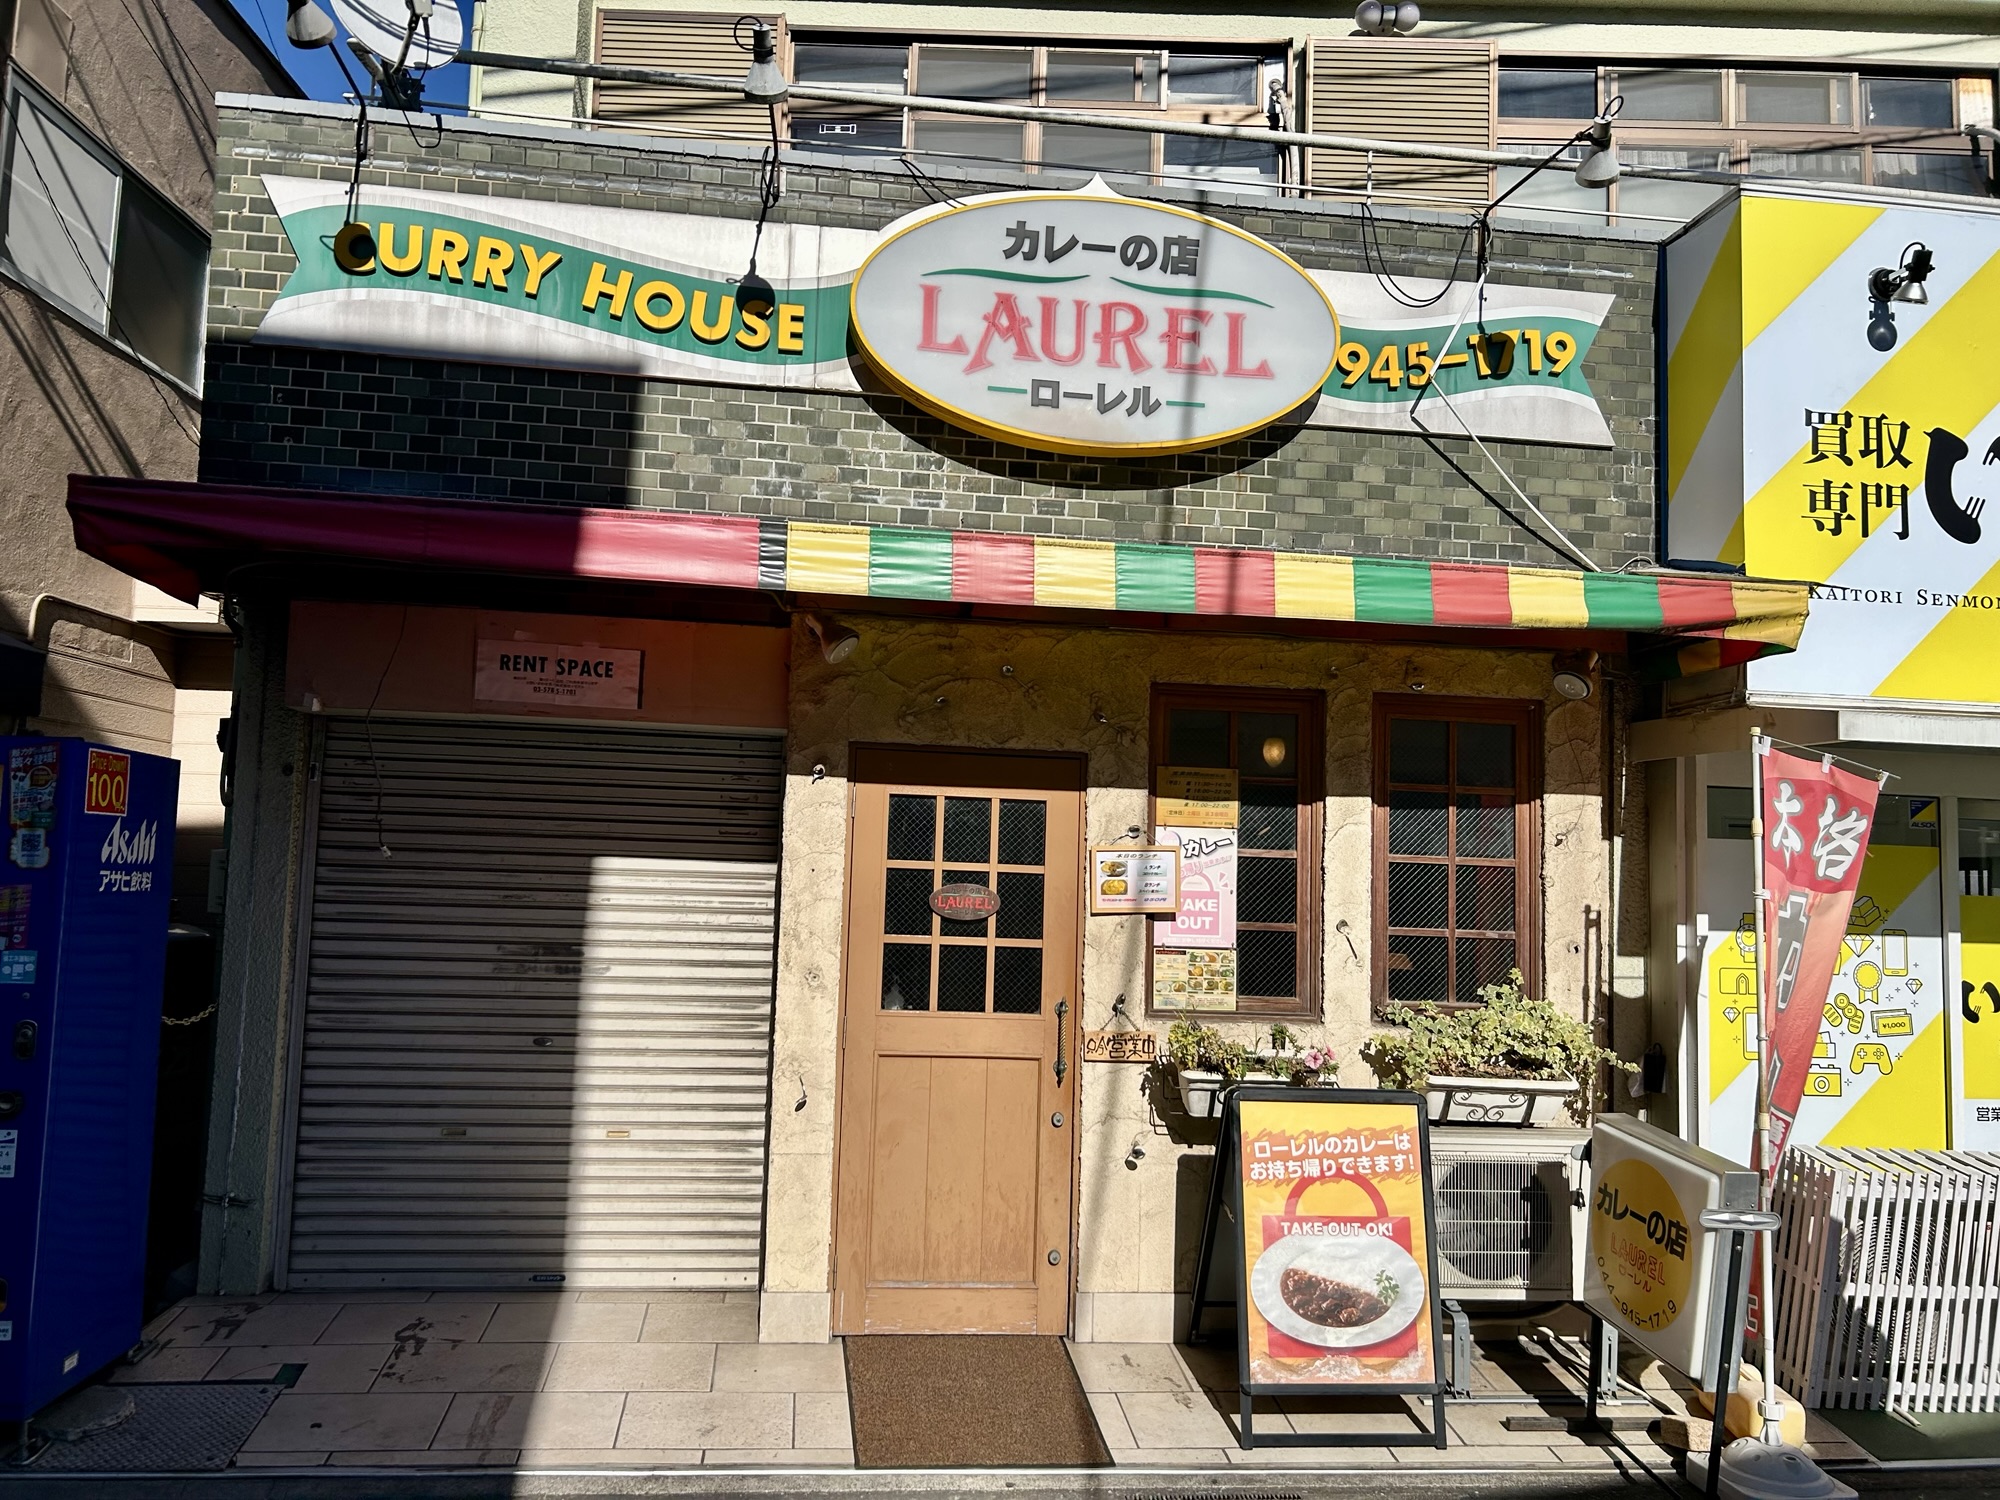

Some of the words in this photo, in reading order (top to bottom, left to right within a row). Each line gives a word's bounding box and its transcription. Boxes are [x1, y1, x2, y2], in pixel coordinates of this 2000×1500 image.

[1001, 220, 1200, 277] カレーの店
[333, 221, 563, 298] CURRY
[580, 261, 806, 354] HOUSE
[916, 283, 1275, 379] LAUREL
[1337, 329, 1578, 388] 945-1719
[1029, 379, 1162, 418] ローレル
[1802, 407, 1913, 469] 買取
[1801, 478, 1910, 541] 専門
[1916, 589, 2000, 610] SENMO
[500, 653, 548, 673] RENT
[556, 657, 614, 679] SPACE
[1771, 781, 1868, 880] 本格
[1911, 821, 1936, 829] ALSOK
[101, 817, 158, 865] Asahi
[1182, 837, 1234, 859] カレー
[98, 870, 152, 892] アサヒ飲料
[937, 896, 993, 910] LAUREL
[1180, 898, 1218, 912] AKE
[1177, 916, 1213, 930] OUT
[1882, 1021, 1906, 1029] ¥1,000
[1254, 1132, 1412, 1158] ローレルのカレーは
[1249, 1153, 1416, 1181] お持ち帰りできます!
[1281, 1221, 1323, 1236] TAKE
[1328, 1222, 1361, 1236] OUT
[1366, 1223, 1393, 1237] OK!
[1597, 1182, 1688, 1262] カレーの店
[1610, 1231, 1666, 1286] LAUREL
[1618, 1263, 1652, 1293] ローレル
